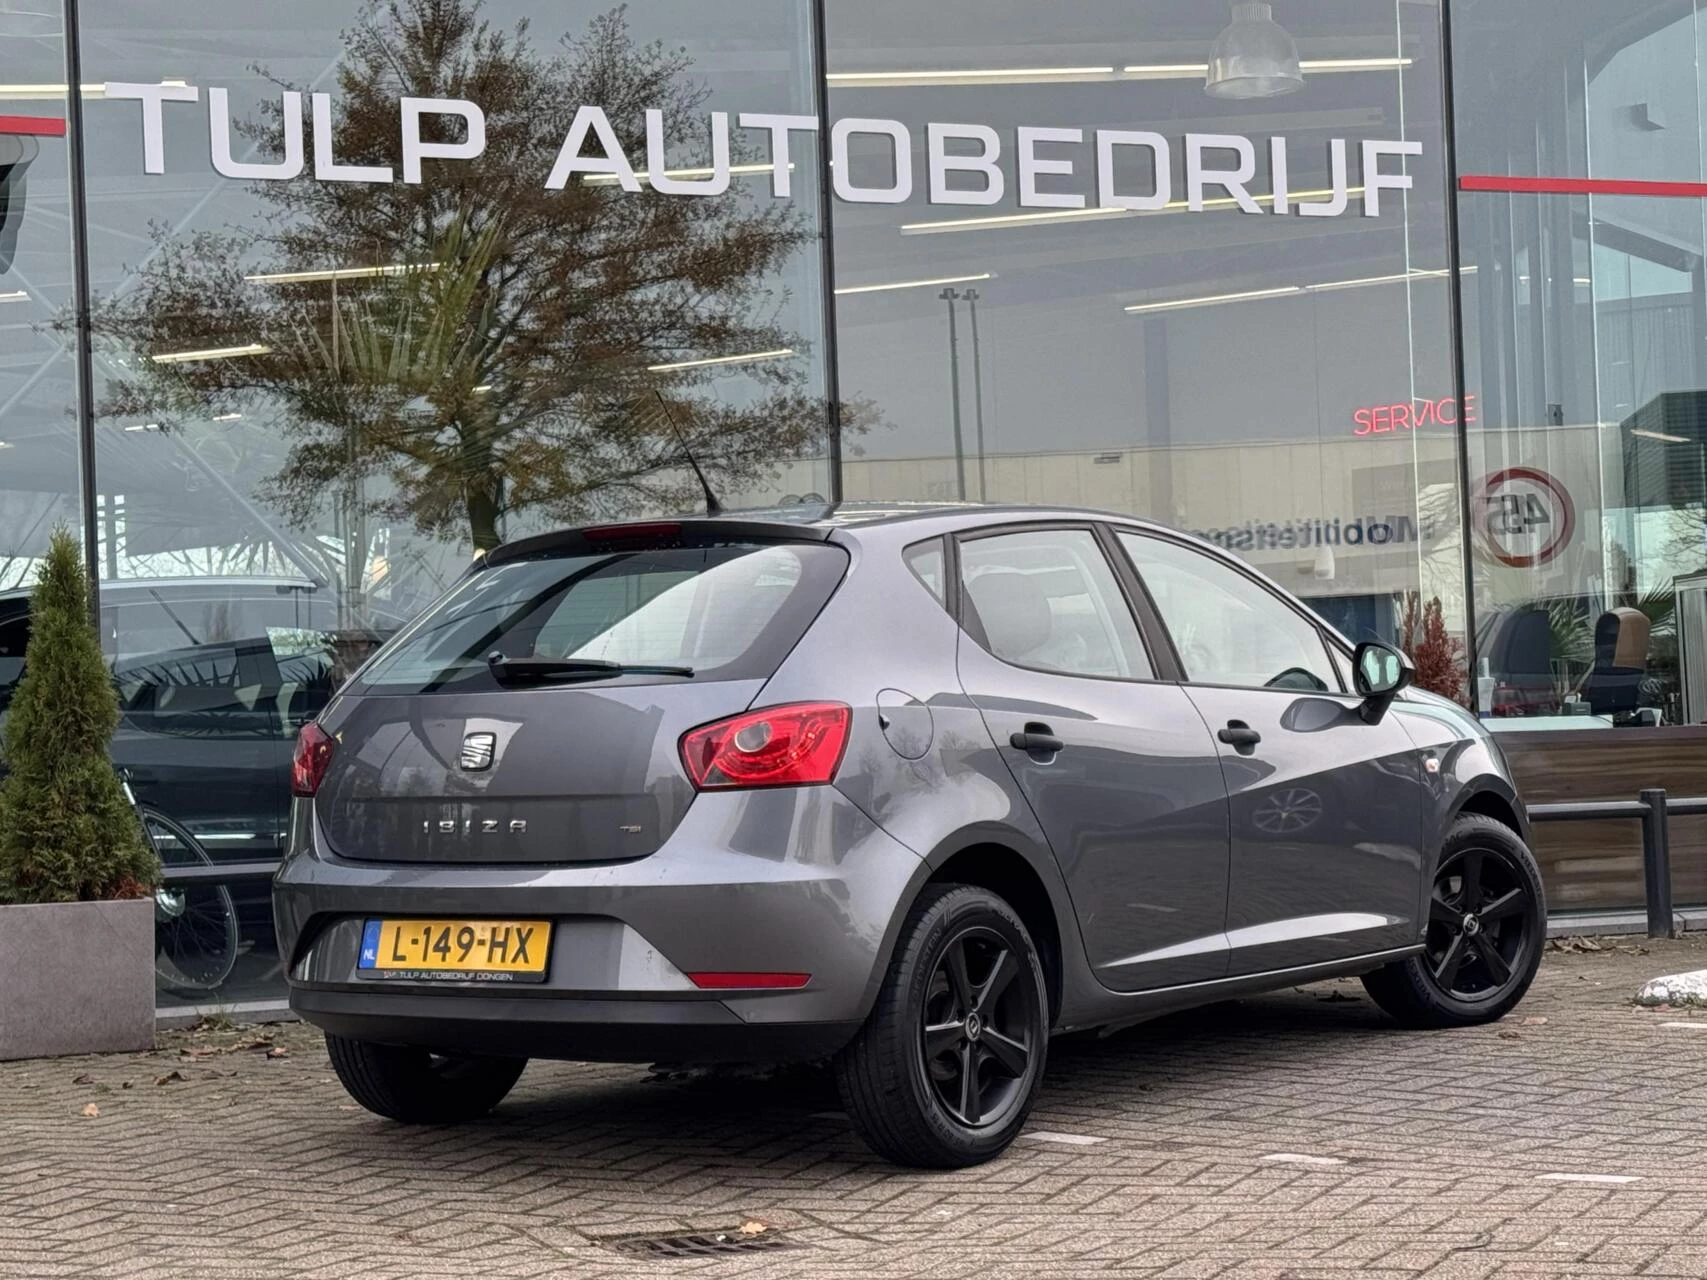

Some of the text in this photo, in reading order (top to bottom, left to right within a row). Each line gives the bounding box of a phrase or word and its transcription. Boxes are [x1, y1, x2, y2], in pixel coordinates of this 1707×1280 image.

[104, 81, 1423, 218] TULP AUTOBEDRIJF
[1353, 393, 1477, 436] SERVICE
[423, 819, 528, 833] IBIZA
[363, 950, 375, 961] NL
[392, 926, 534, 963] L-149-HX
[399, 971, 418, 979] TULP
